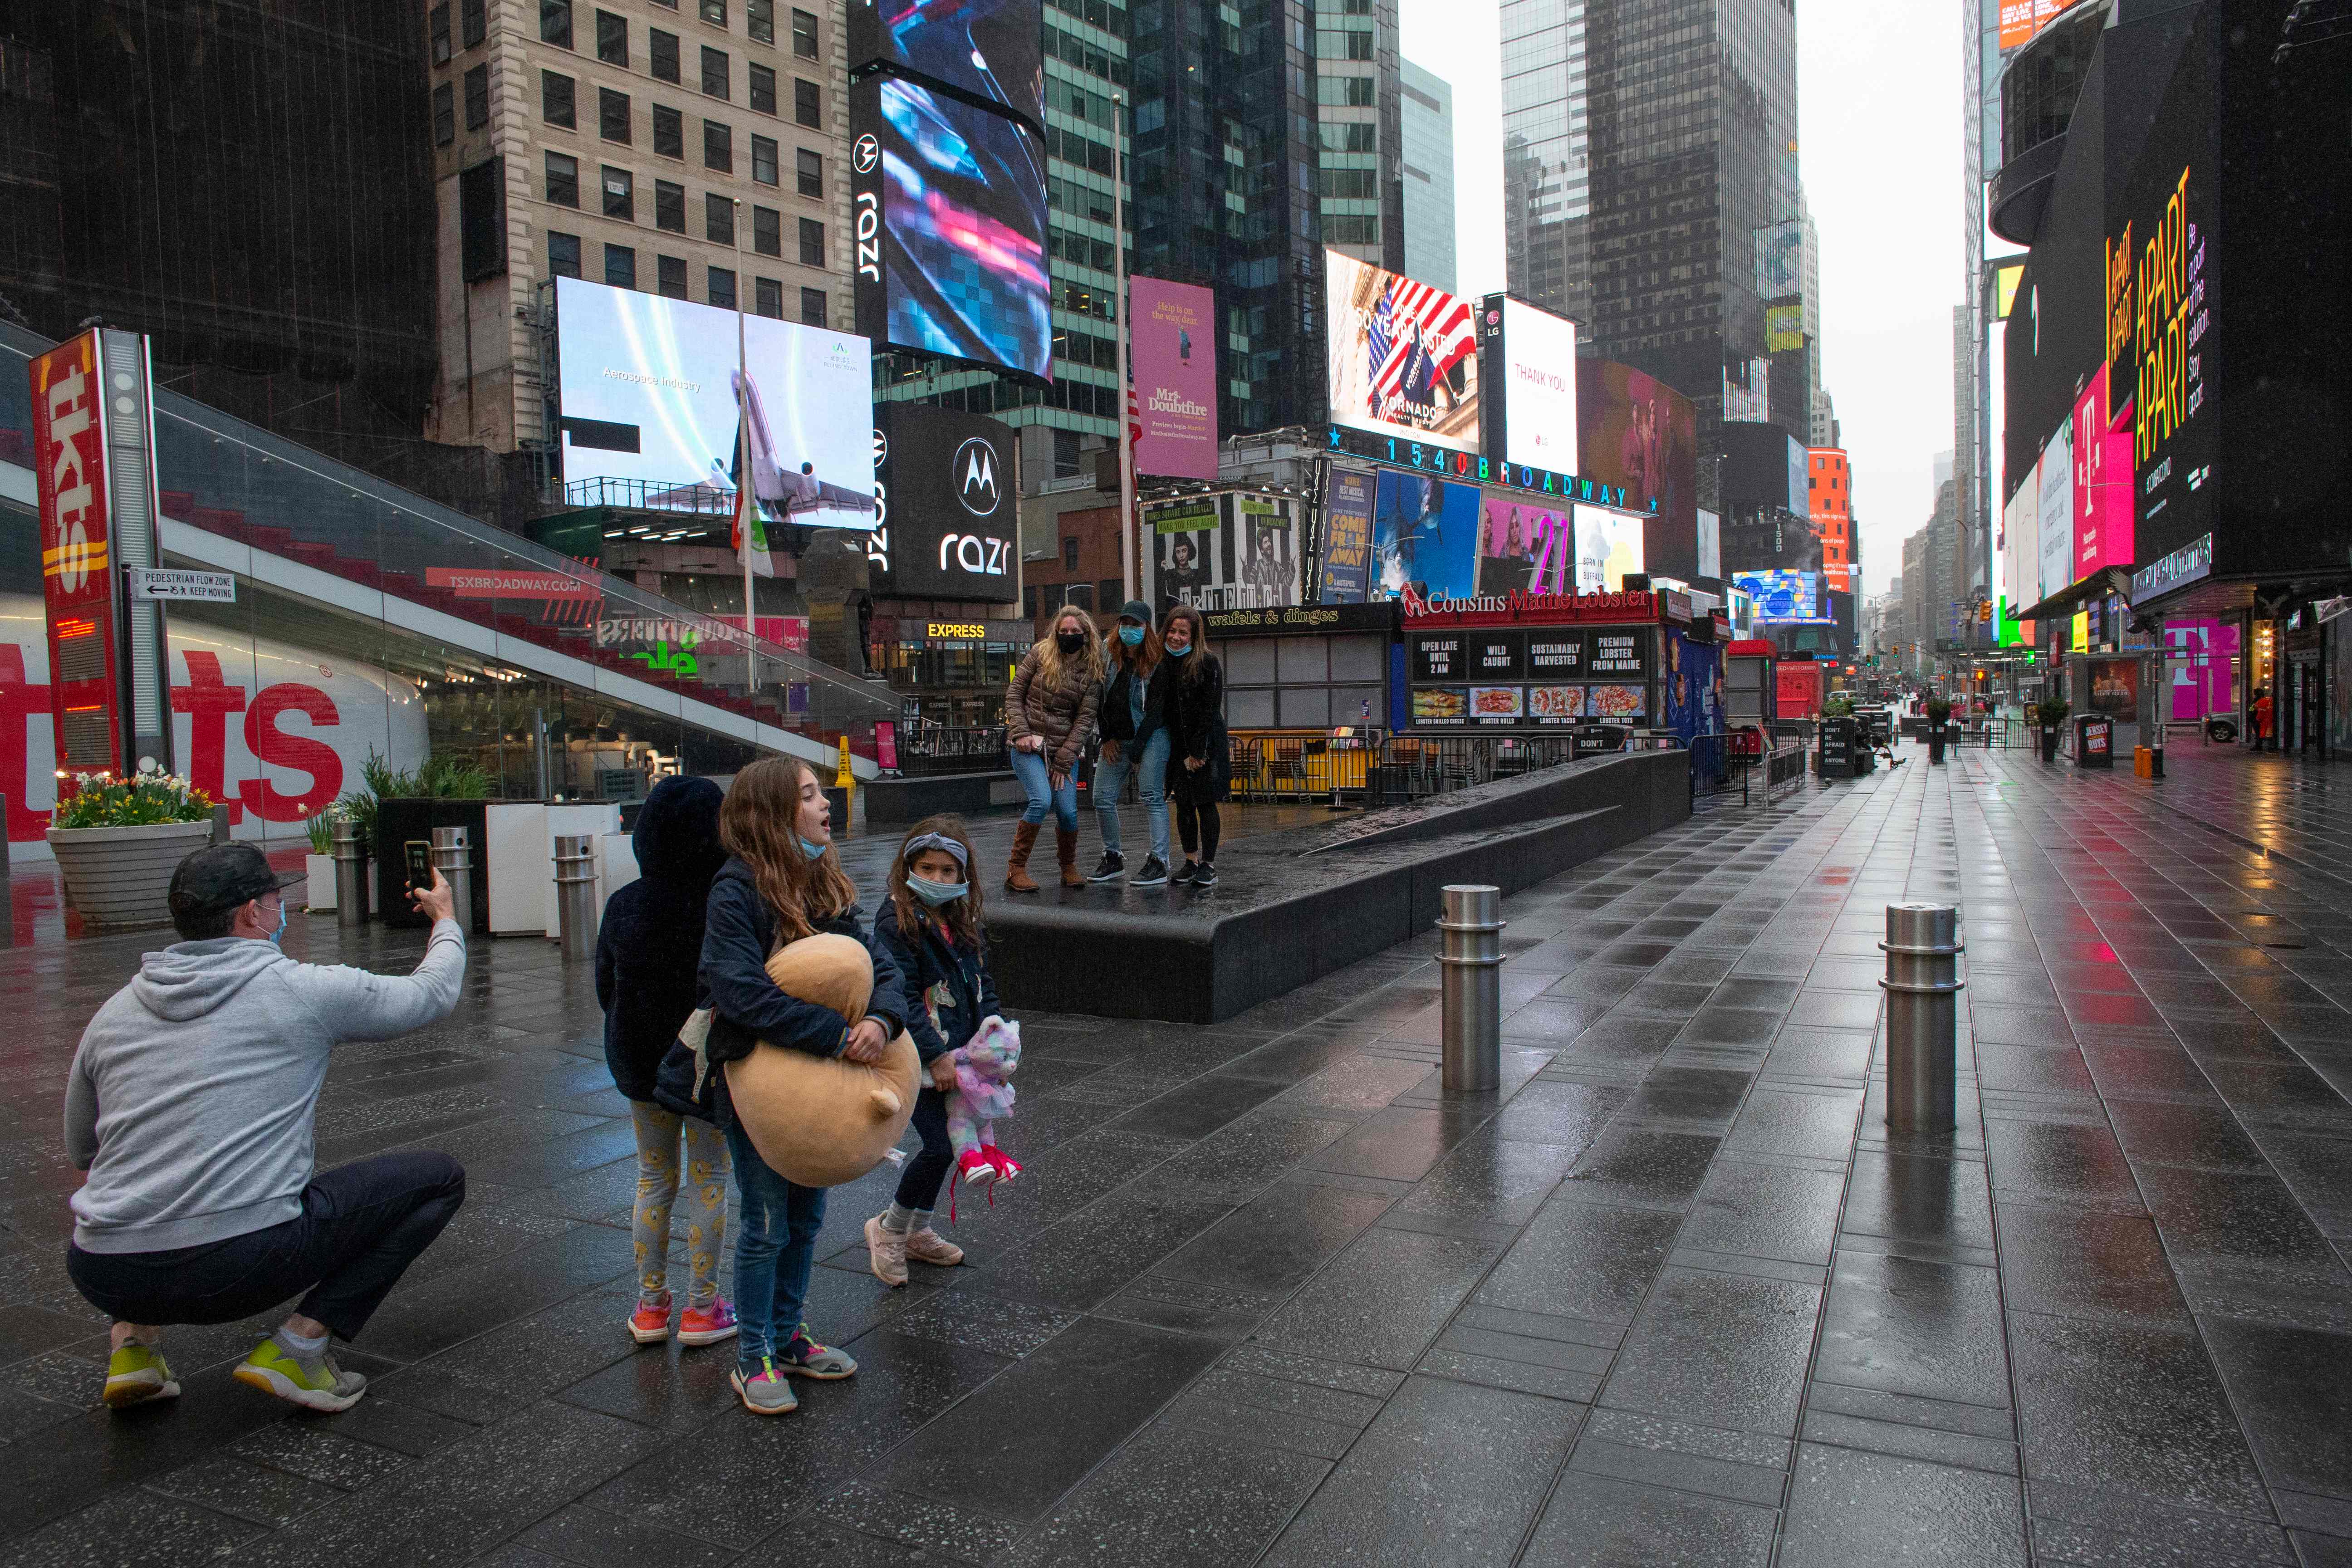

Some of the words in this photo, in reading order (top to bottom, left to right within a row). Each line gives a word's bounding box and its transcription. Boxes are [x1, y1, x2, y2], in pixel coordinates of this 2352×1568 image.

[858, 193, 879, 282] razr
[2136, 165, 2190, 367] APART
[1158, 301, 1175, 314] Help
[1177, 304, 1182, 313] is
[1152, 311, 1164, 320] the
[1488, 327, 1499, 337] LG
[603, 367, 658, 385] Aerospace
[661, 377, 701, 393] Industry
[1515, 363, 1546, 386] THANK
[1548, 374, 1565, 392] YOU
[2135, 296, 2189, 471] APART
[1156, 387, 1181, 401] Mrs.
[1148, 397, 1207, 416] Doubtfire
[1383, 395, 1437, 419] VORNADO
[48, 364, 88, 593] tkts
[1387, 438, 1467, 474] 1540
[1478, 456, 1626, 506] BROADWAY
[1332, 514, 1367, 533] COME
[941, 534, 1011, 575] razr
[1328, 548, 1365, 567] AWAY
[1583, 557, 1596, 567] BORN
[1598, 559, 1603, 567] IN
[146, 573, 194, 584] PEDESTRIAN
[197, 575, 213, 585] FLOW
[216, 577, 231, 586] ZONE
[1583, 571, 1603, 582] BUFFALO
[449, 576, 581, 591] TSXBROADWAY.COM
[191, 587, 206, 595] KEEP
[209, 587, 232, 598] MOVING
[1427, 591, 1507, 613] Cousins
[1509, 588, 1570, 610] Maine
[1573, 585, 1650, 609] Lobster
[1208, 611, 1260, 626] wafels
[1265, 610, 1278, 624] &
[1284, 608, 1339, 625] dinges
[928, 624, 985, 638] EXPRESS
[1421, 642, 1439, 651] OPEN
[1441, 641, 1458, 651] LATE
[1598, 637, 1634, 647] PREMIUM
[1487, 646, 1506, 655] WILD
[1531, 644, 1580, 654] SUSTAINABLY
[1600, 648, 1633, 658] LOBSTER
[1430, 652, 1450, 662] UNTIL
[1483, 657, 1511, 666] CAUGHT
[1535, 655, 1577, 666] HARVESTED
[1431, 664, 1435, 674] 2
[1437, 664, 1448, 673] AM
[1592, 660, 1613, 670] FROM
[1616, 659, 1641, 670] MAINE
[2085, 723, 2108, 736] JERSEY
[2088, 737, 2106, 750] BOYS
